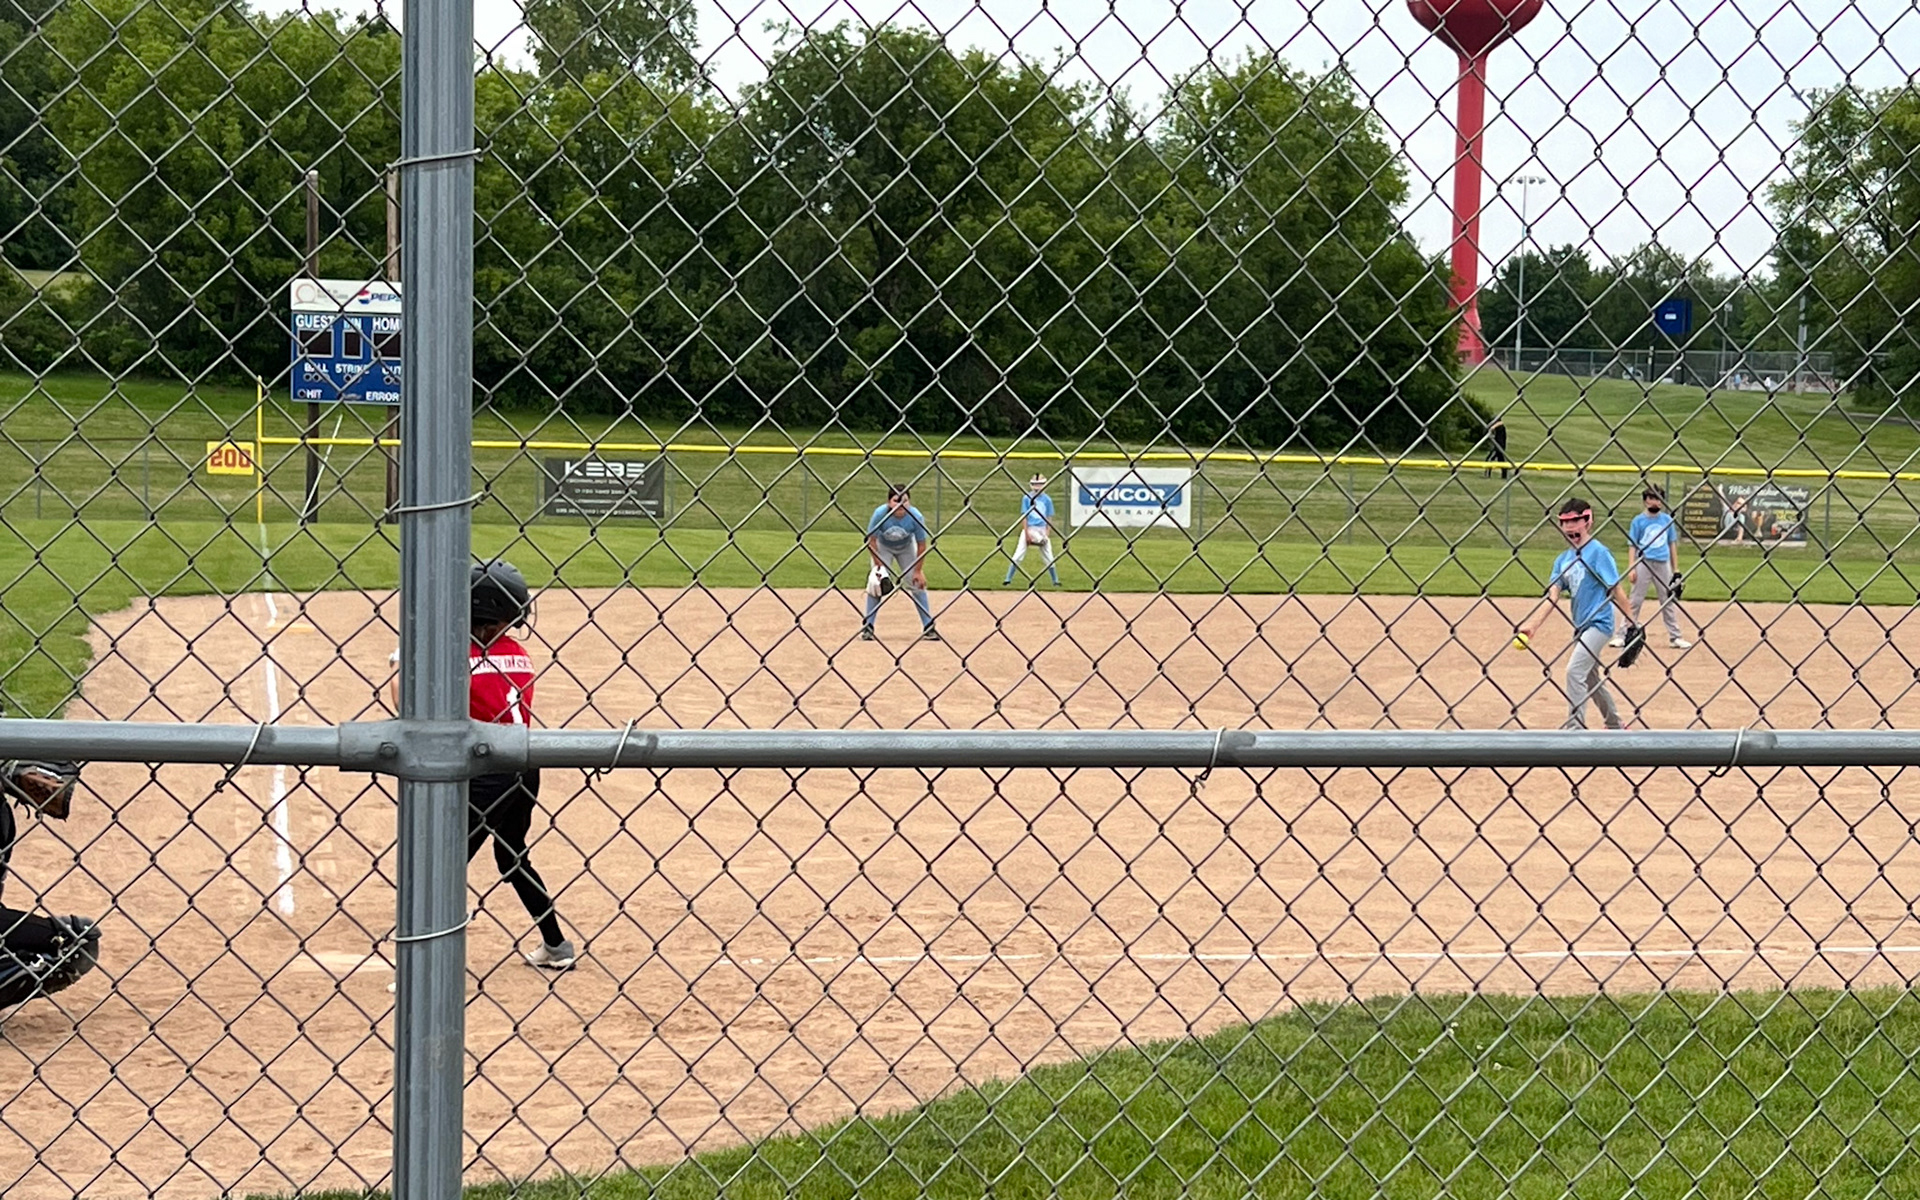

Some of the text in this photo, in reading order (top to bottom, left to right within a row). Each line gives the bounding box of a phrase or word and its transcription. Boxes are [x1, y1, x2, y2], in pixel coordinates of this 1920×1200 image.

[295, 315, 334, 328] GUEST
[372, 318, 401, 331] HOM
[306, 389, 323, 399] HIT
[210, 448, 251, 468] 200
[564, 461, 646, 478] KEBE
[1089, 487, 1166, 502] TRICOR
